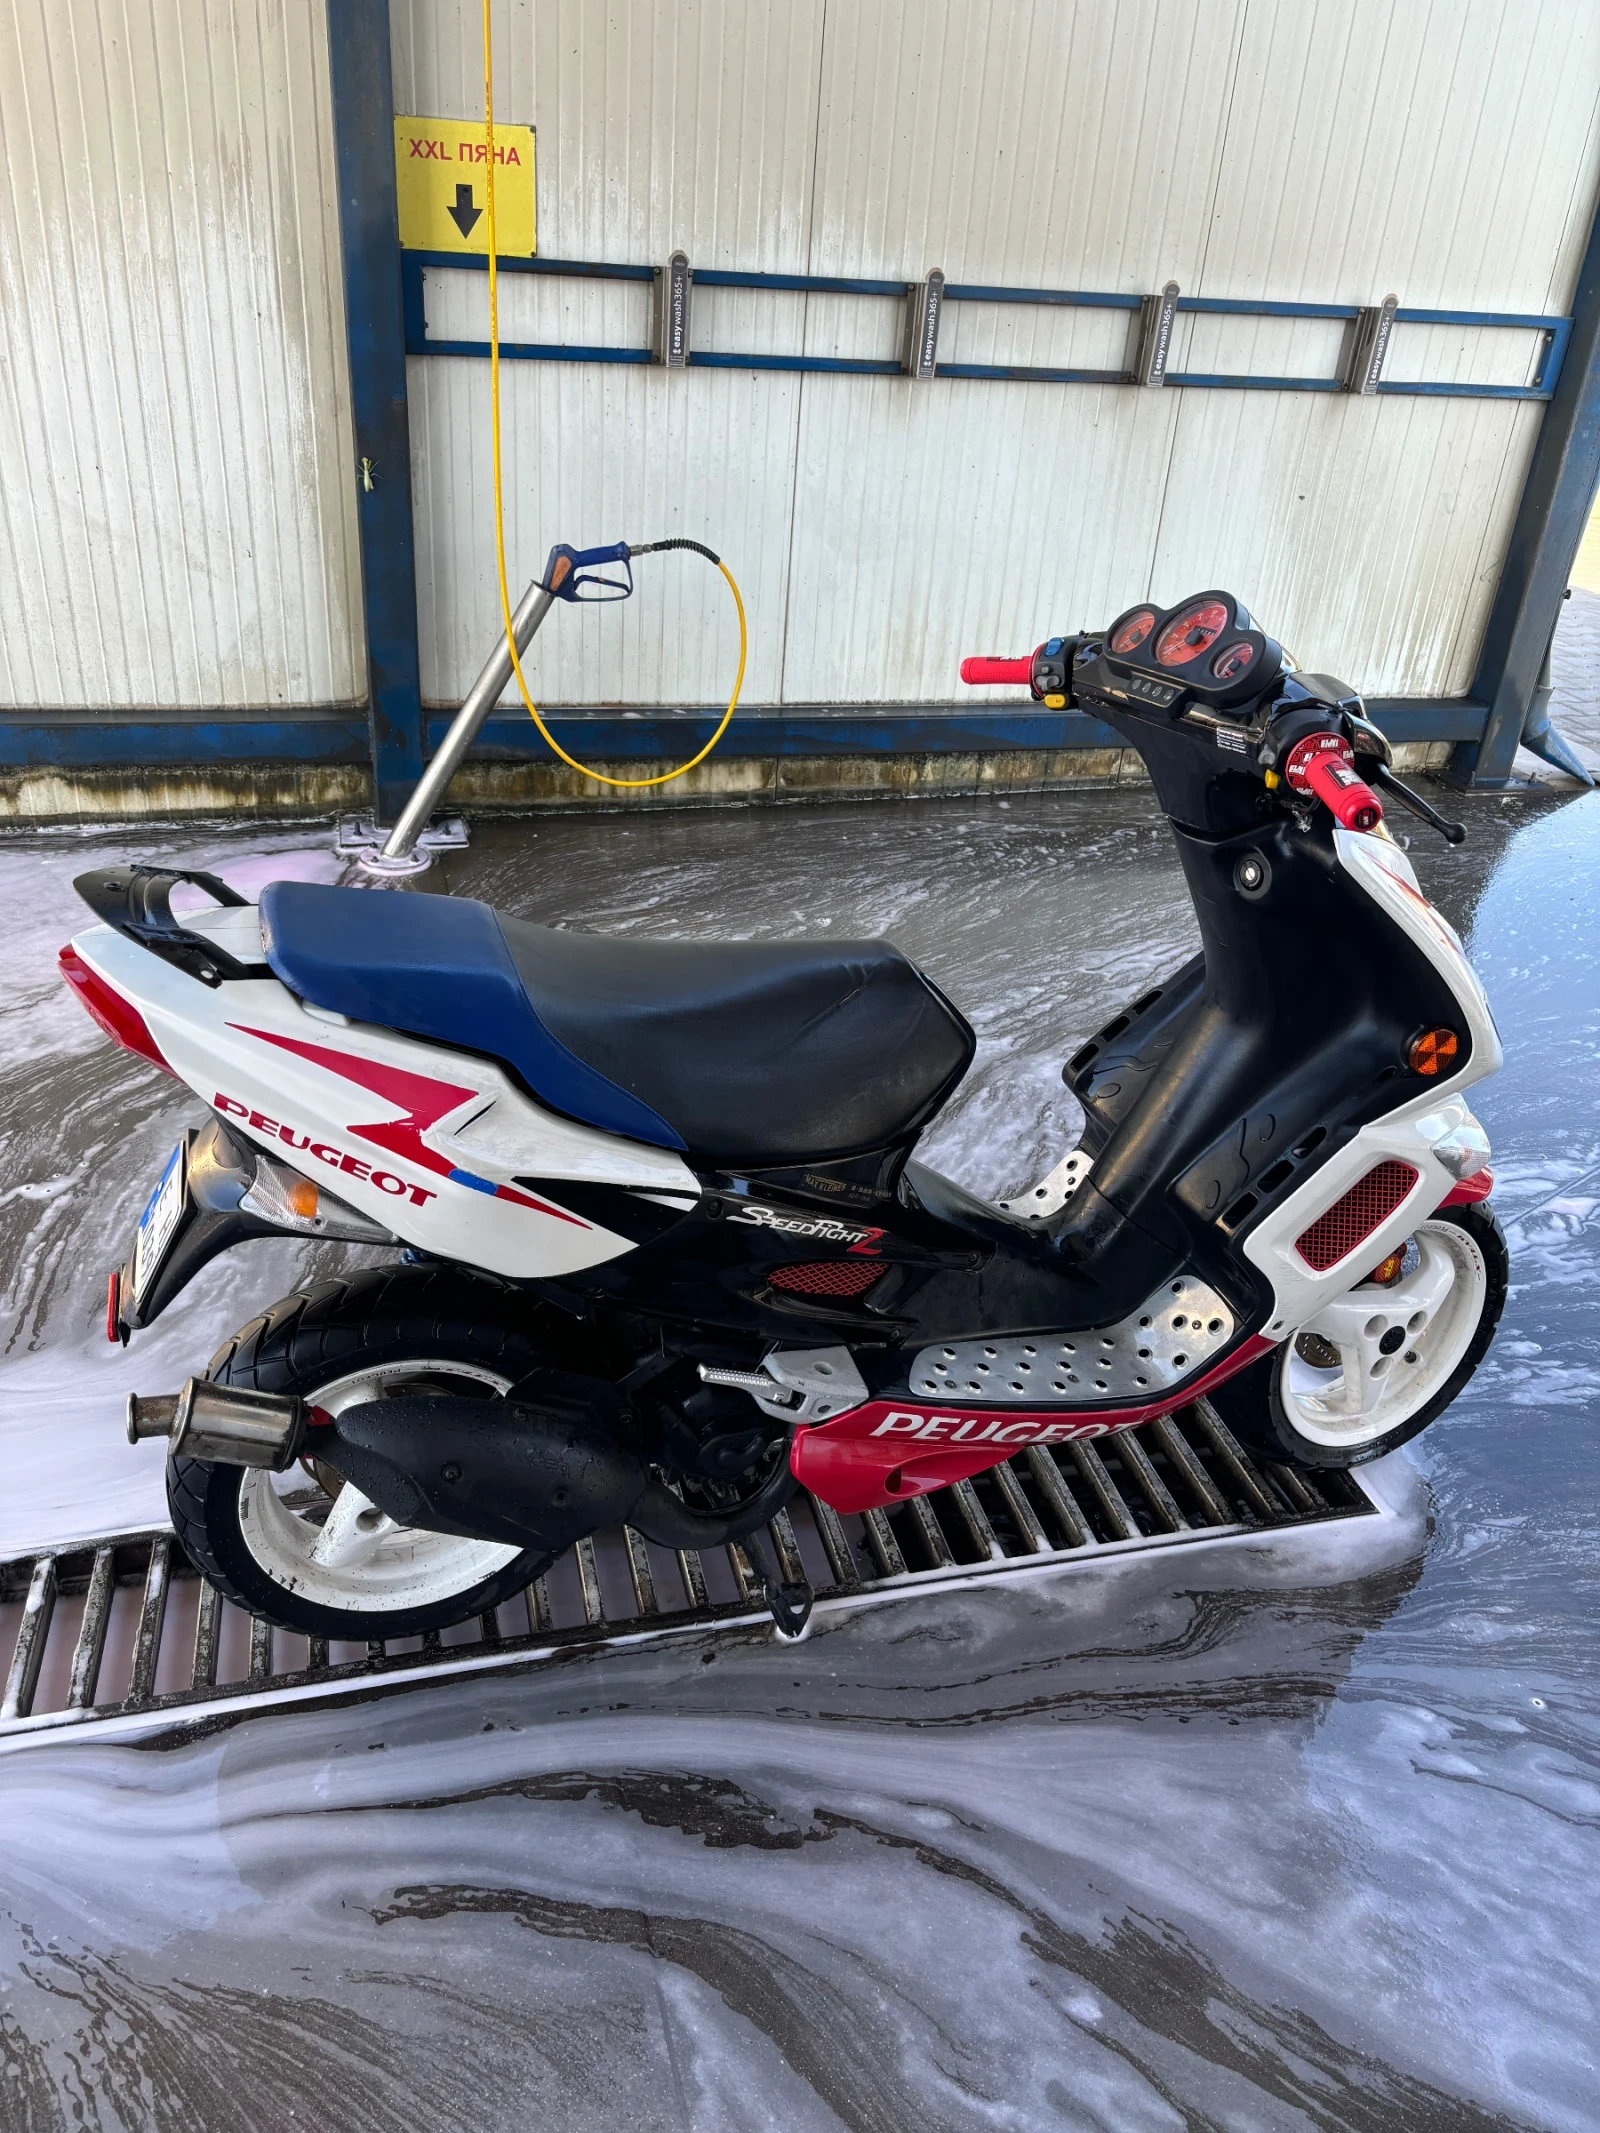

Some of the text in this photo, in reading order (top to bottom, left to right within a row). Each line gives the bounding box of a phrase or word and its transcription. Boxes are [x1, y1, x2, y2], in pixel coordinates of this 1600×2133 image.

[409, 138, 521, 166] XXL ПЯНА
[213, 1092, 438, 1207] PEUGEOT
[869, 1411, 1143, 1443] PEUGEOT
